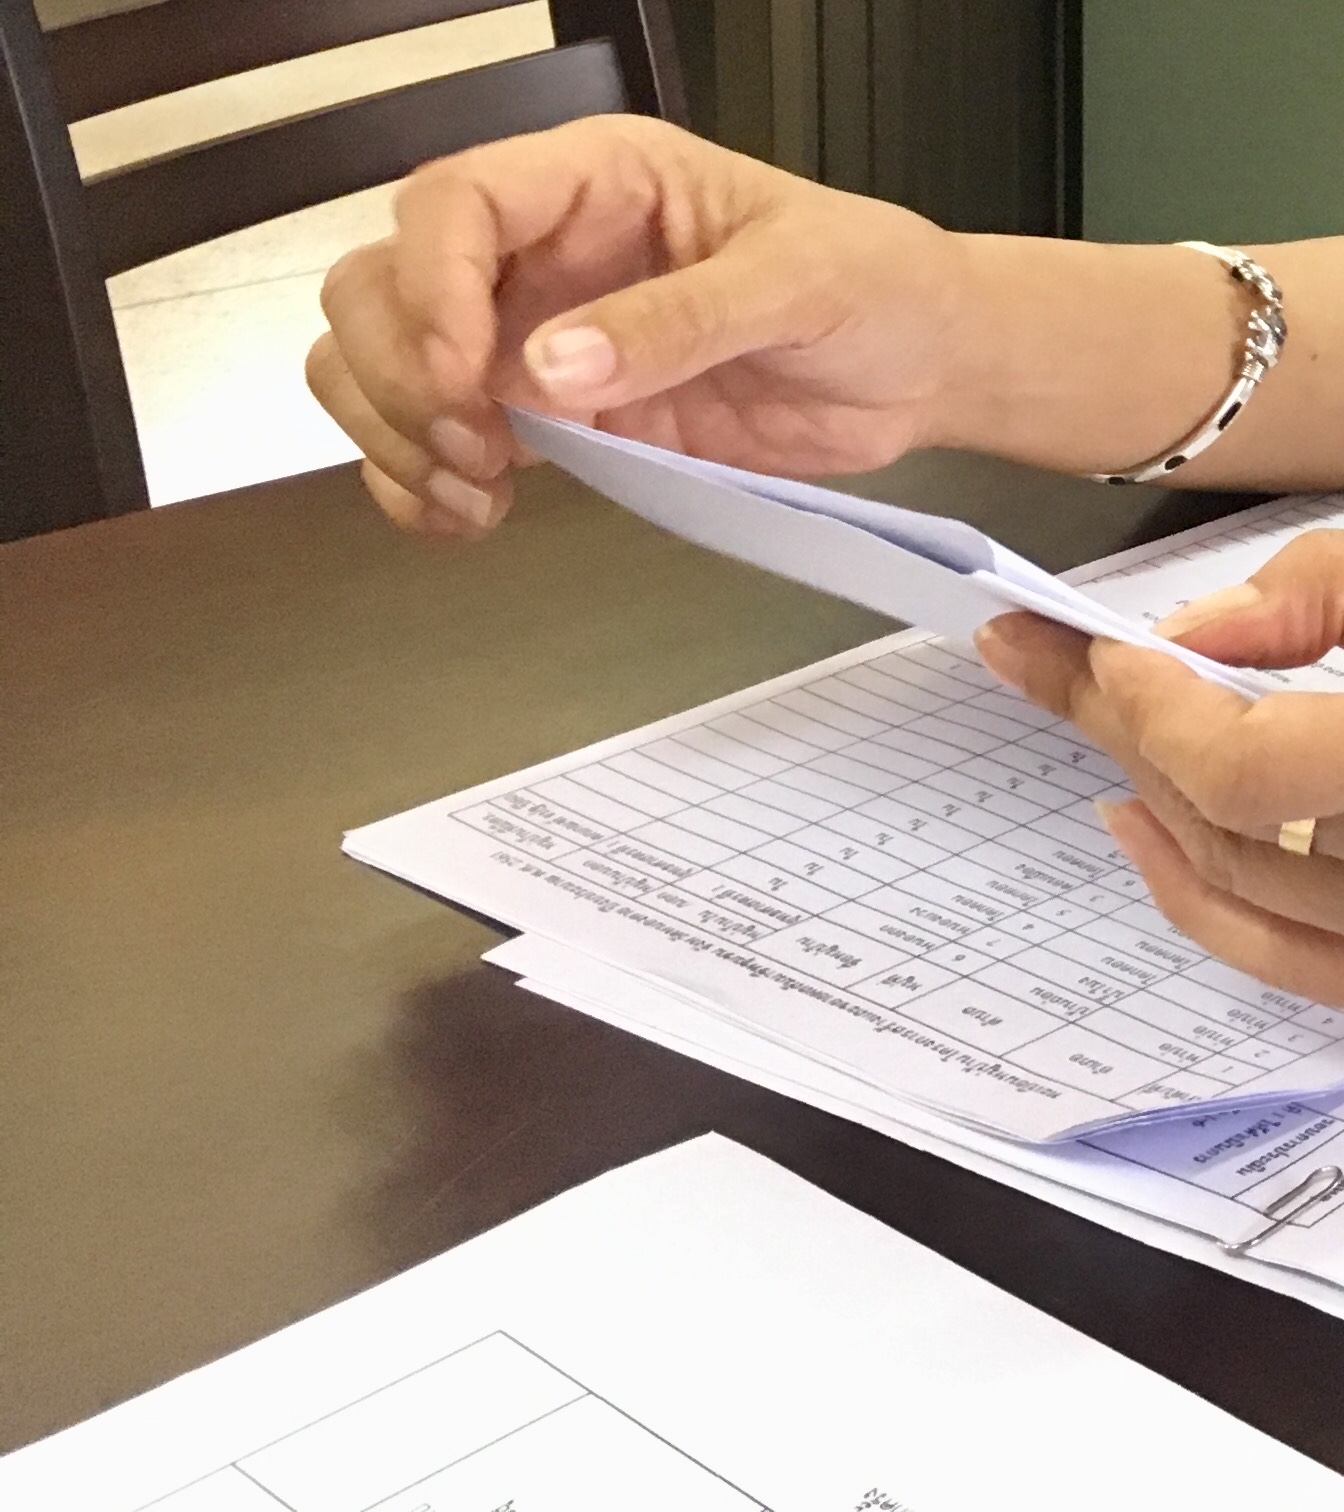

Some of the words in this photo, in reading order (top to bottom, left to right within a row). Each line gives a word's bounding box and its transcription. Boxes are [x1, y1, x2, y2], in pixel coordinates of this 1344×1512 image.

[961, 1006, 1004, 1027] ตำบล
[1226, 1008, 1270, 1033] ท่าบ่อ
[1192, 1025, 1235, 1047] ท่าบ่อ
[1068, 1053, 1114, 1075] อำเภอ
[1157, 1042, 1201, 1067] ท่าบ่อ
[1235, 1118, 1336, 1177] รอบการประเมิน
